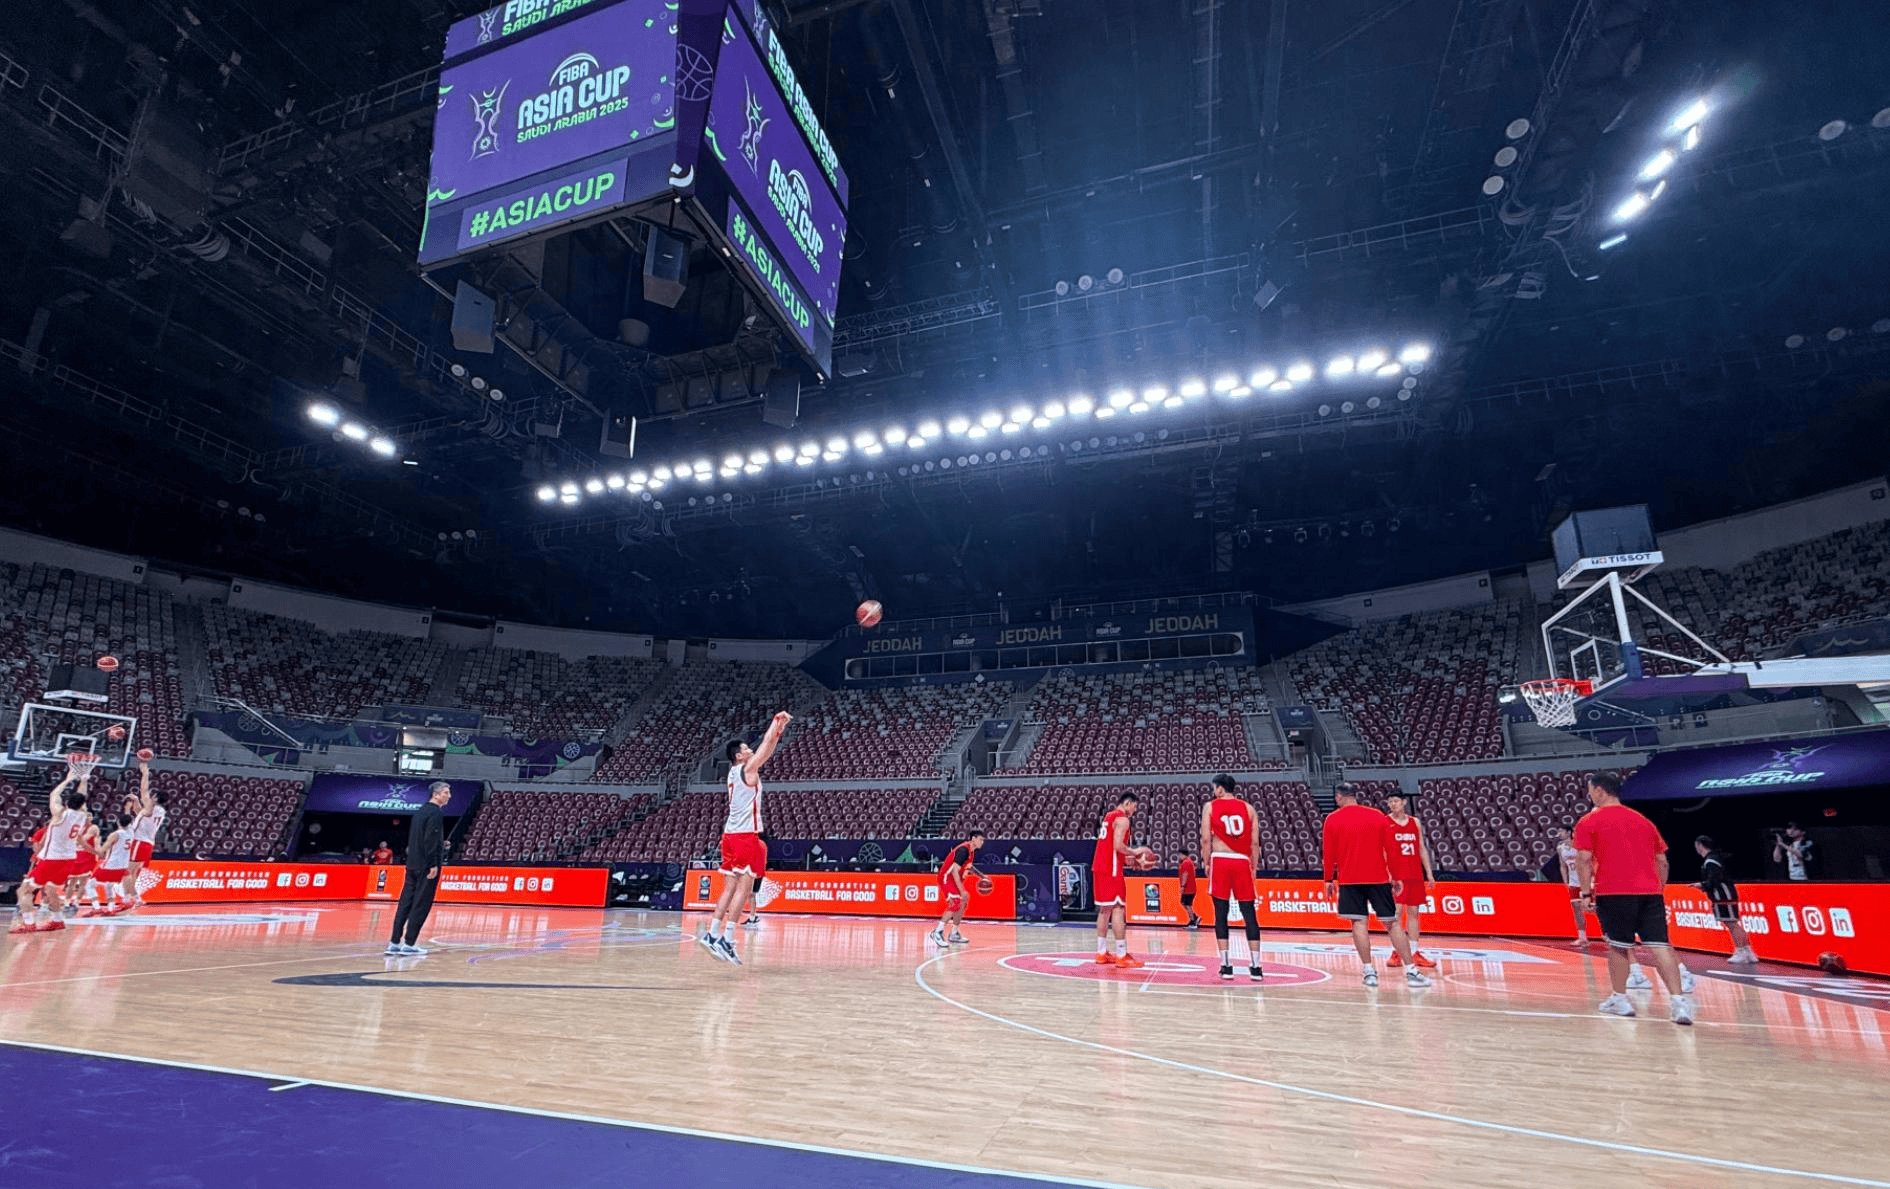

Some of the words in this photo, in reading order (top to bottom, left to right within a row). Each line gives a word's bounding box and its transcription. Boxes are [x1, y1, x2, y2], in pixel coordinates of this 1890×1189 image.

[502, 8, 547, 37] SAUDI
[558, 61, 590, 87] FIBA
[517, 85, 574, 130] ASIA
[578, 65, 631, 109] CUP
[768, 28, 795, 94] FIBA
[795, 82, 819, 139] ASIA
[819, 128, 839, 170] CUP
[516, 122, 552, 144] SAUDI
[553, 107, 598, 132] ARABIA
[599, 96, 630, 117] 2025
[792, 176, 809, 210] FIBA
[469, 172, 615, 238] #ASIACUP
[768, 159, 800, 226] ASIA
[799, 209, 825, 258] CUP
[733, 214, 810, 330] #ASIACUP
[1607, 553, 1652, 564] TISSOT
[1144, 613, 1219, 634] JEDDAH
[863, 637, 923, 654] JEDDAH
[995, 626, 1062, 646] JEDDAH
[68, 823, 81, 839] 6
[1220, 814, 1244, 836] 10
[1400, 843, 1416, 856] 21
[165, 878, 225, 889] BASKETBALL
[226, 878, 244, 889] FOR
[245, 879, 269, 889] GOOD
[784, 889, 834, 901] BASKETBALL
[836, 890, 852, 901] FOR
[853, 890, 876, 902] GOOD
[1269, 901, 1339, 914] BASKETBALL
[1741, 914, 1770, 934] GOOD
